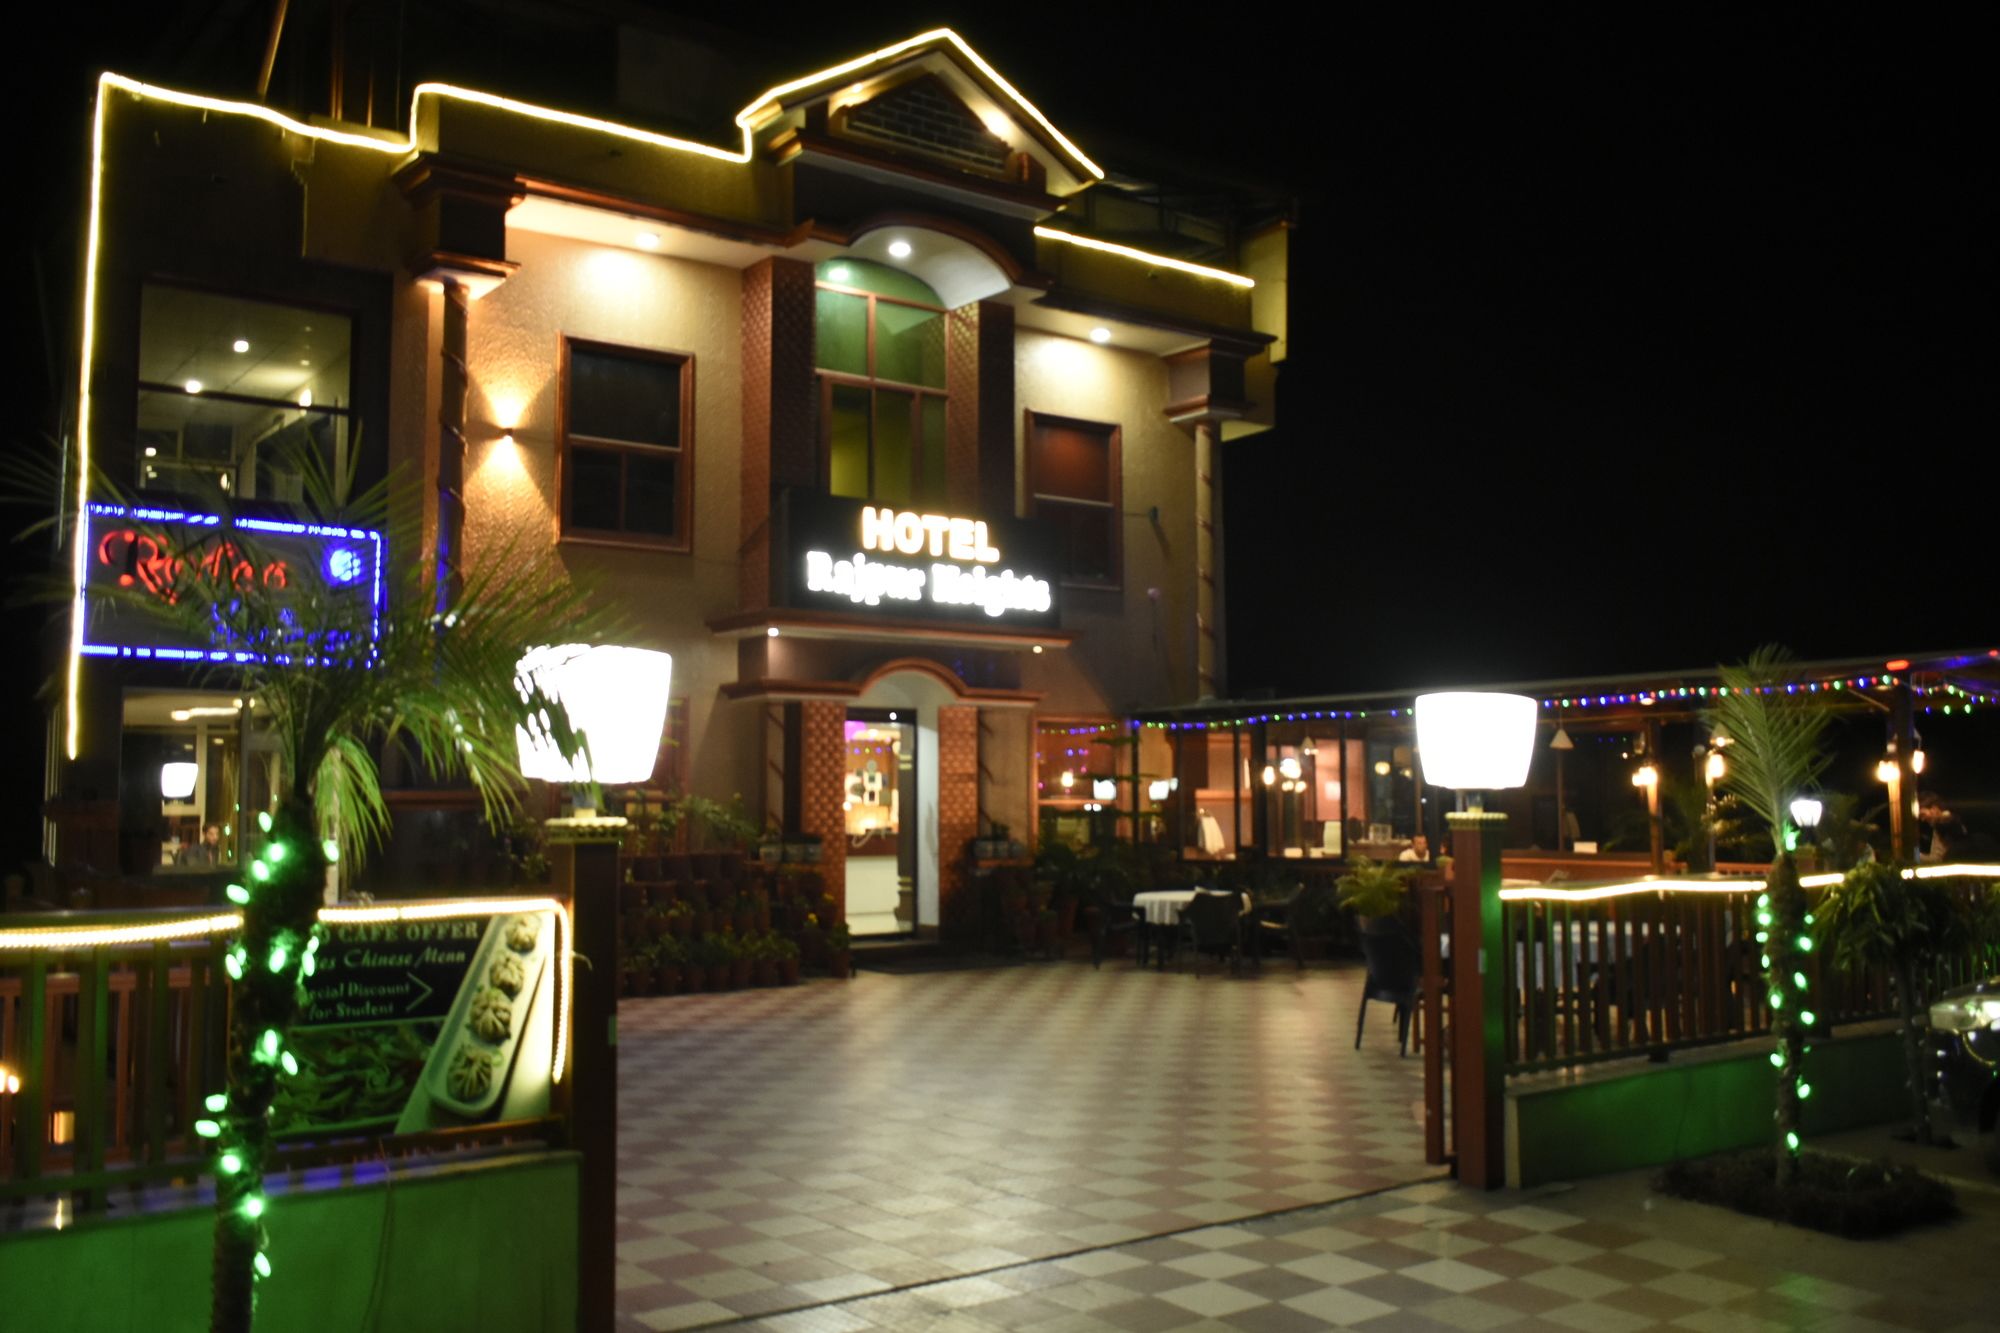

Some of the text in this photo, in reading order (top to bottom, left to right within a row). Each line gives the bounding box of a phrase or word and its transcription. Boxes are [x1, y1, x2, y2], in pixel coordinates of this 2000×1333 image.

[862, 506, 1000, 563] HOTEL
[806, 550, 926, 606] Rajpur
[338, 923, 399, 943] CAFE
[406, 920, 479, 942] OFFER
[343, 949, 412, 969] Chinese
[348, 982, 410, 999] Discount
[309, 1001, 394, 1021] for Student
